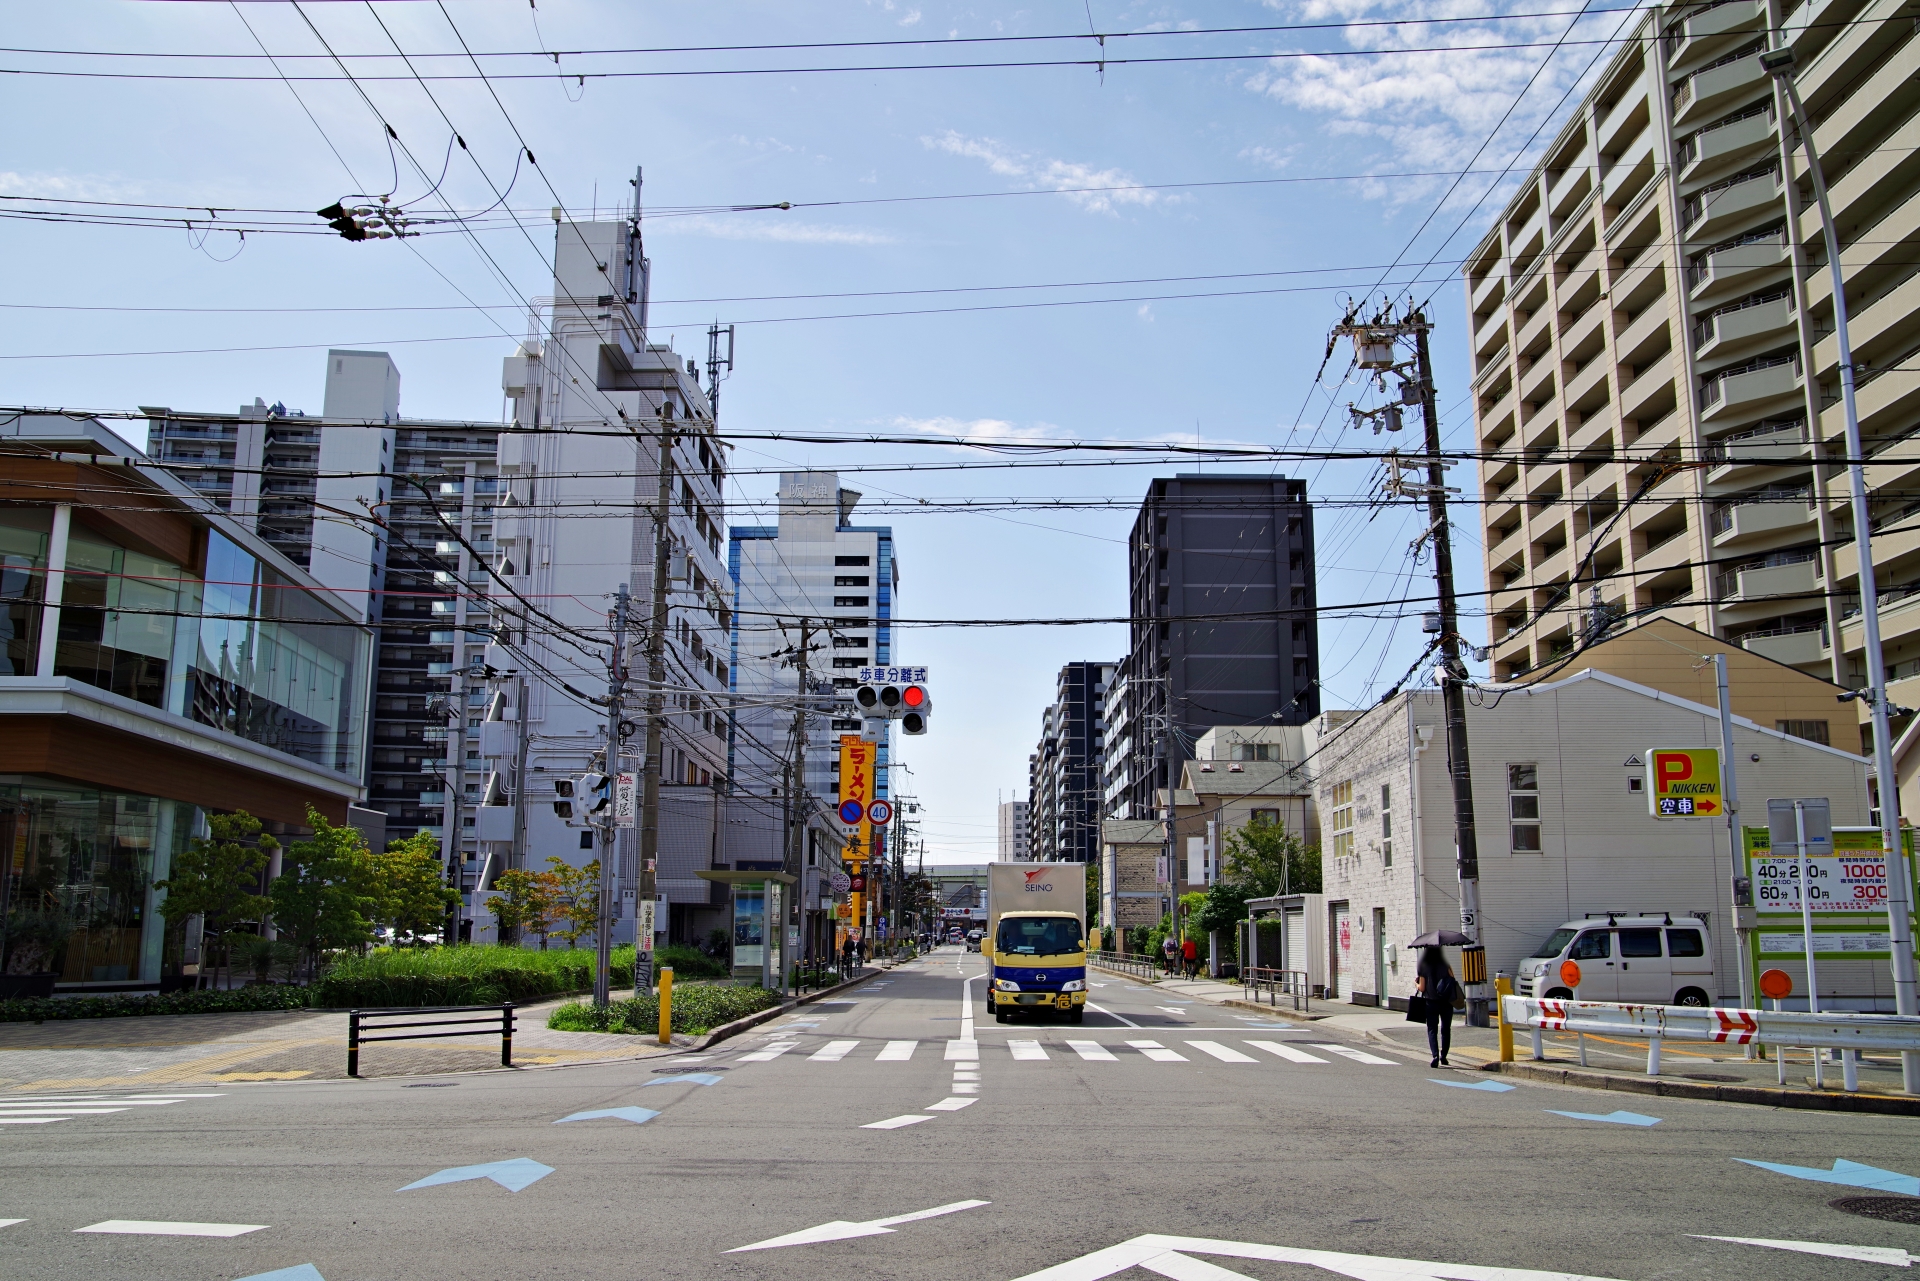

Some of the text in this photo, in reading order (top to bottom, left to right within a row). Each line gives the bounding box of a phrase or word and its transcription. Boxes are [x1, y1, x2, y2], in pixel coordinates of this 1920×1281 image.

[789, 483, 828, 499] 阪神
[860, 667, 926, 682] 歩車分離式
[849, 747, 865, 801] ラーメン
[1656, 753, 1693, 793] P
[1671, 783, 1716, 794] NIKKEN
[872, 806, 887, 819] 40
[1660, 797, 1693, 815] 空車
[1789, 865, 1828, 878] 20円
[1025, 883, 1053, 892] SEINO
[1793, 886, 1829, 899] 10円
[1057, 994, 1071, 1009] 危
